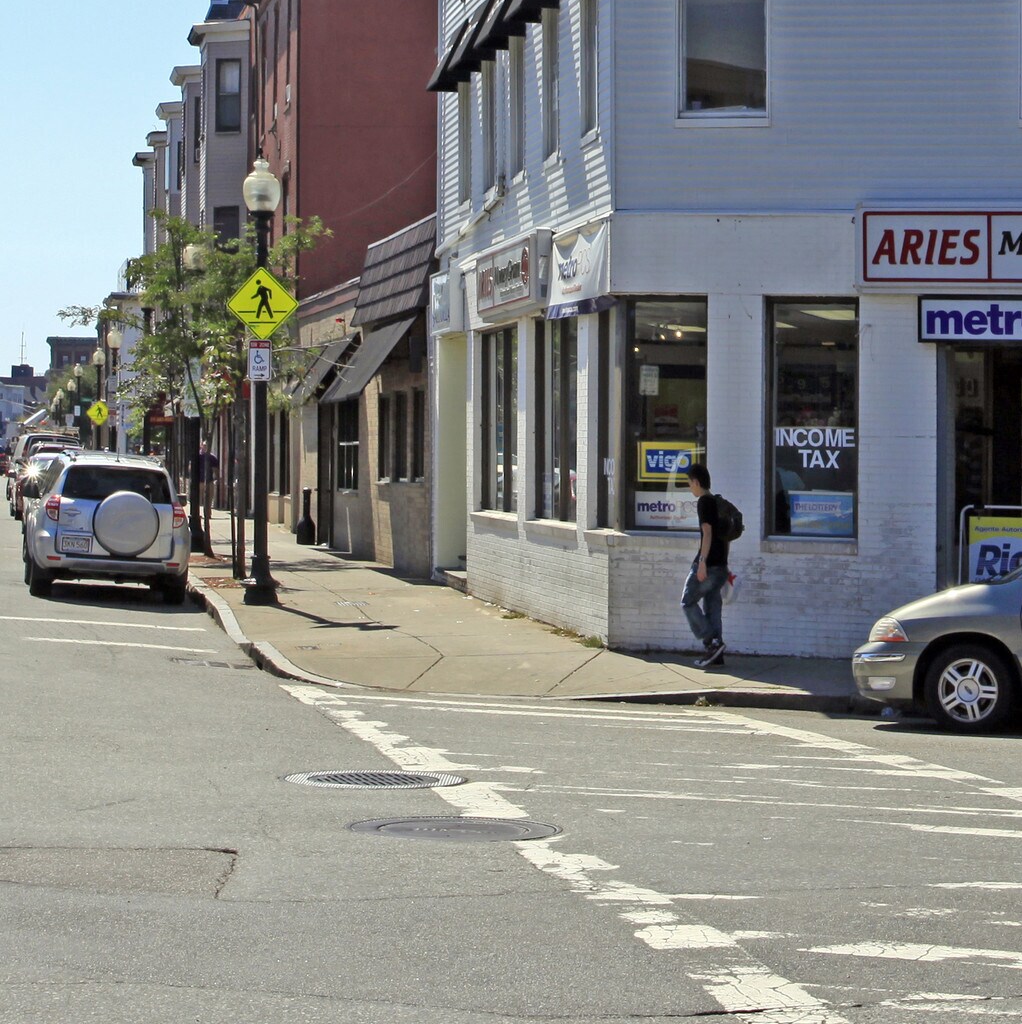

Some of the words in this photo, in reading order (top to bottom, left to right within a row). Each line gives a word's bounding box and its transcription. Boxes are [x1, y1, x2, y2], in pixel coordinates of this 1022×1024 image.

[872, 229, 980, 265] ARIES
[775, 428, 856, 447] INCOME
[646, 451, 690, 472] vigo
[798, 449, 840, 469] TAX
[975, 526, 999, 534] Agente
